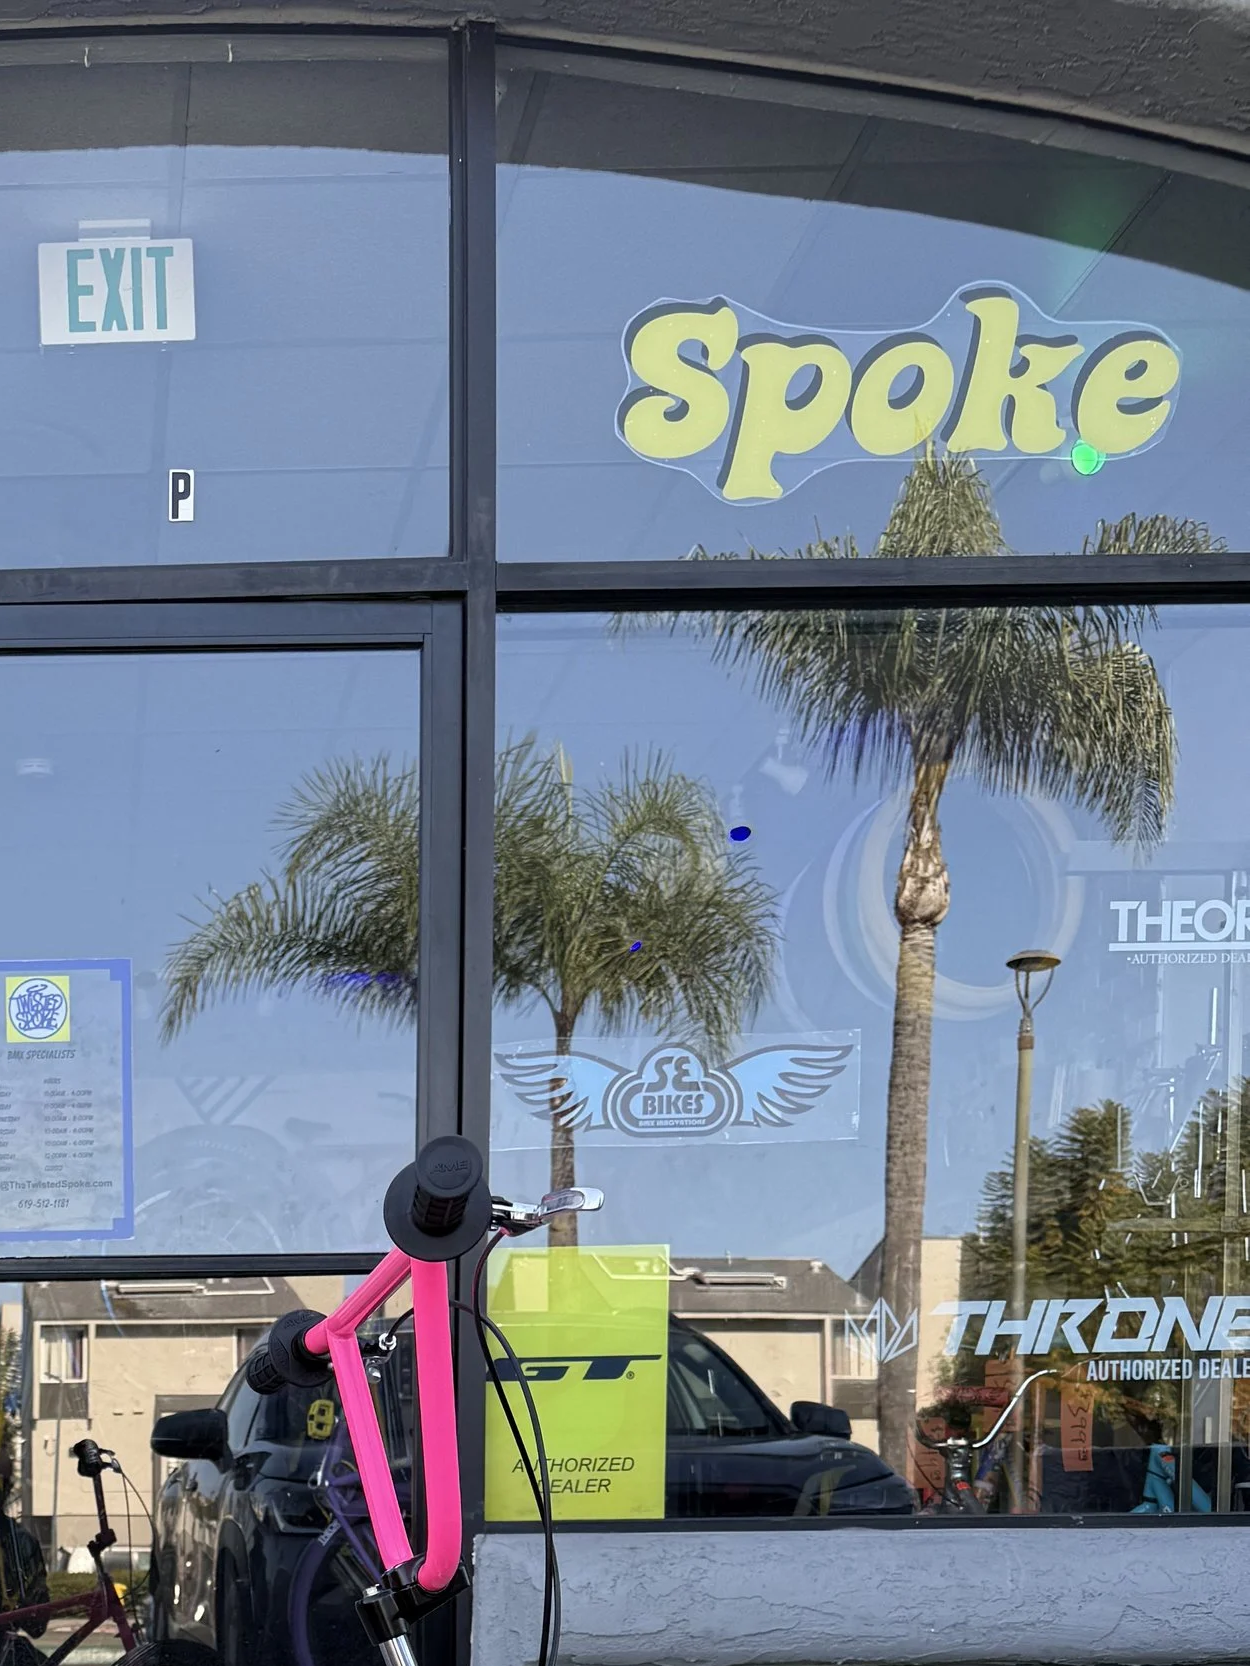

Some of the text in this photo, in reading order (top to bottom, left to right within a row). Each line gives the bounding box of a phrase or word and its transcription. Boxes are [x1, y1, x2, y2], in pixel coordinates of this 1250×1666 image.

[66, 246, 174, 332] EXIT
[618, 288, 1180, 499] Spoke
[171, 471, 191, 519] P
[1131, 953, 1217, 964] AUTHORIZED
[25, 1049, 76, 1060] SPECIALISTS
[645, 1055, 701, 1093] SE
[642, 1094, 704, 1116] BIKES
[1087, 1360, 1192, 1381] AUTHORIZED
